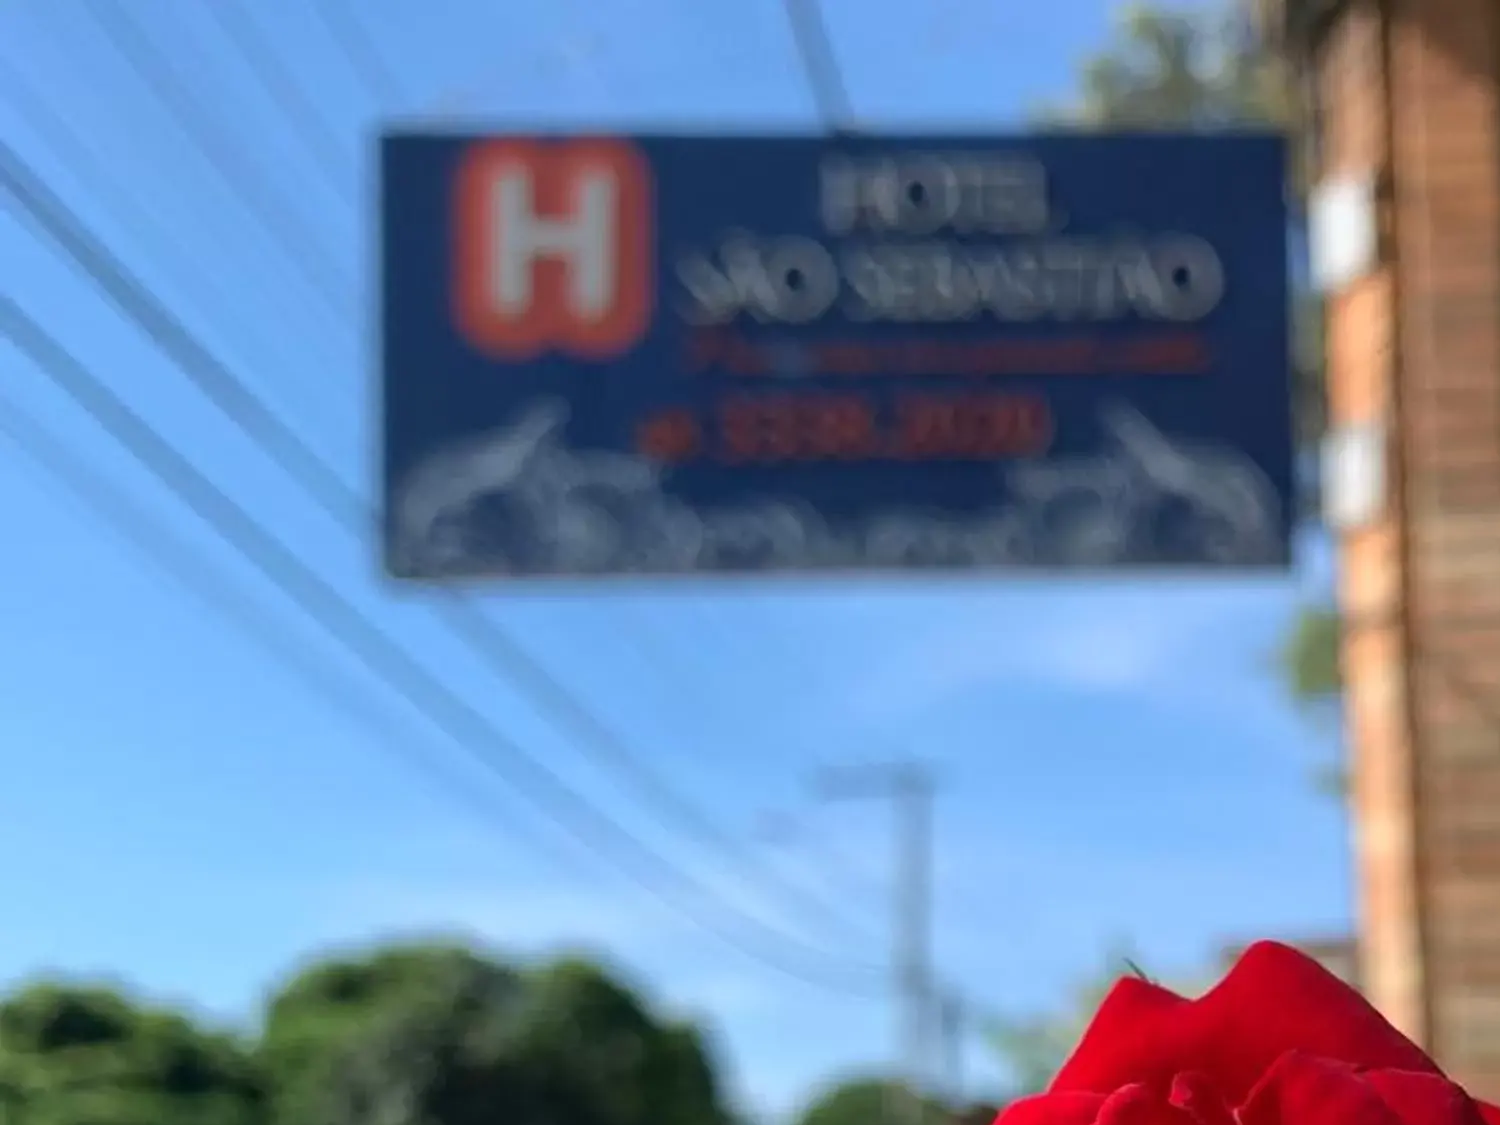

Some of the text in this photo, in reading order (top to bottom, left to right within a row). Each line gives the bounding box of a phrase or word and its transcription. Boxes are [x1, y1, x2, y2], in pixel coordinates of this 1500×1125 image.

[486, 158, 622, 320] H
[820, 152, 1056, 236] HOTEL
[677, 230, 838, 324] SÃO
